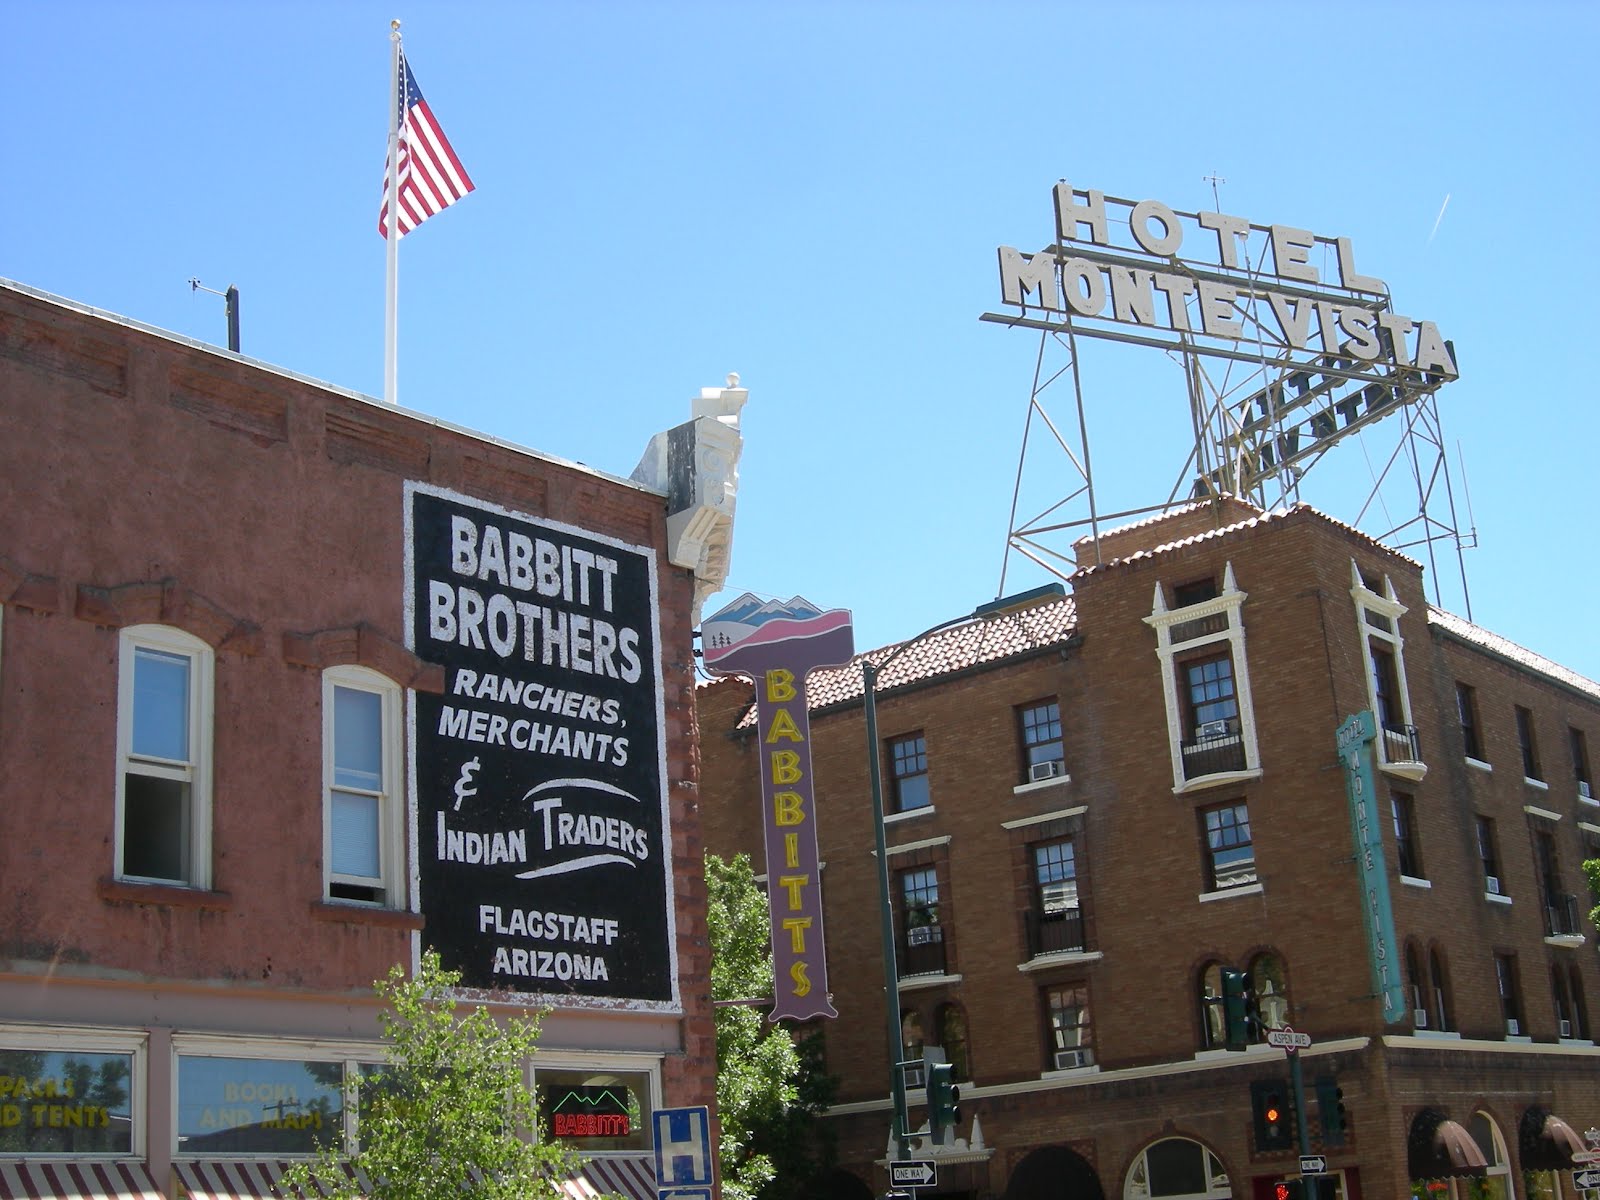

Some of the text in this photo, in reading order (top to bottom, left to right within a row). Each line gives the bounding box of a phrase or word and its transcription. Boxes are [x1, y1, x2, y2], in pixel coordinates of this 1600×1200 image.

[1053, 183, 1385, 295] HOTEL
[998, 245, 1458, 378] MONTE VISTA
[451, 514, 618, 613] BABBITT
[429, 579, 642, 684] BROTHERS
[453, 668, 628, 728] RANCHERS,
[438, 705, 630, 767] MERCHANTS
[453, 756, 481, 811] &
[437, 797, 649, 865] INDIAN TRADERS
[765, 668, 813, 998] BABBITTS
[479, 904, 619, 945] FLAGSTAFF
[493, 947, 609, 982] ARIZONA
[1273, 1033, 1307, 1045] ASPEN AVE
[32, 1104, 110, 1128] TENTS
[199, 1107, 322, 1130] AND MAPS
[659, 1112, 706, 1183] H
[896, 1169, 925, 1179] ONE WAY
